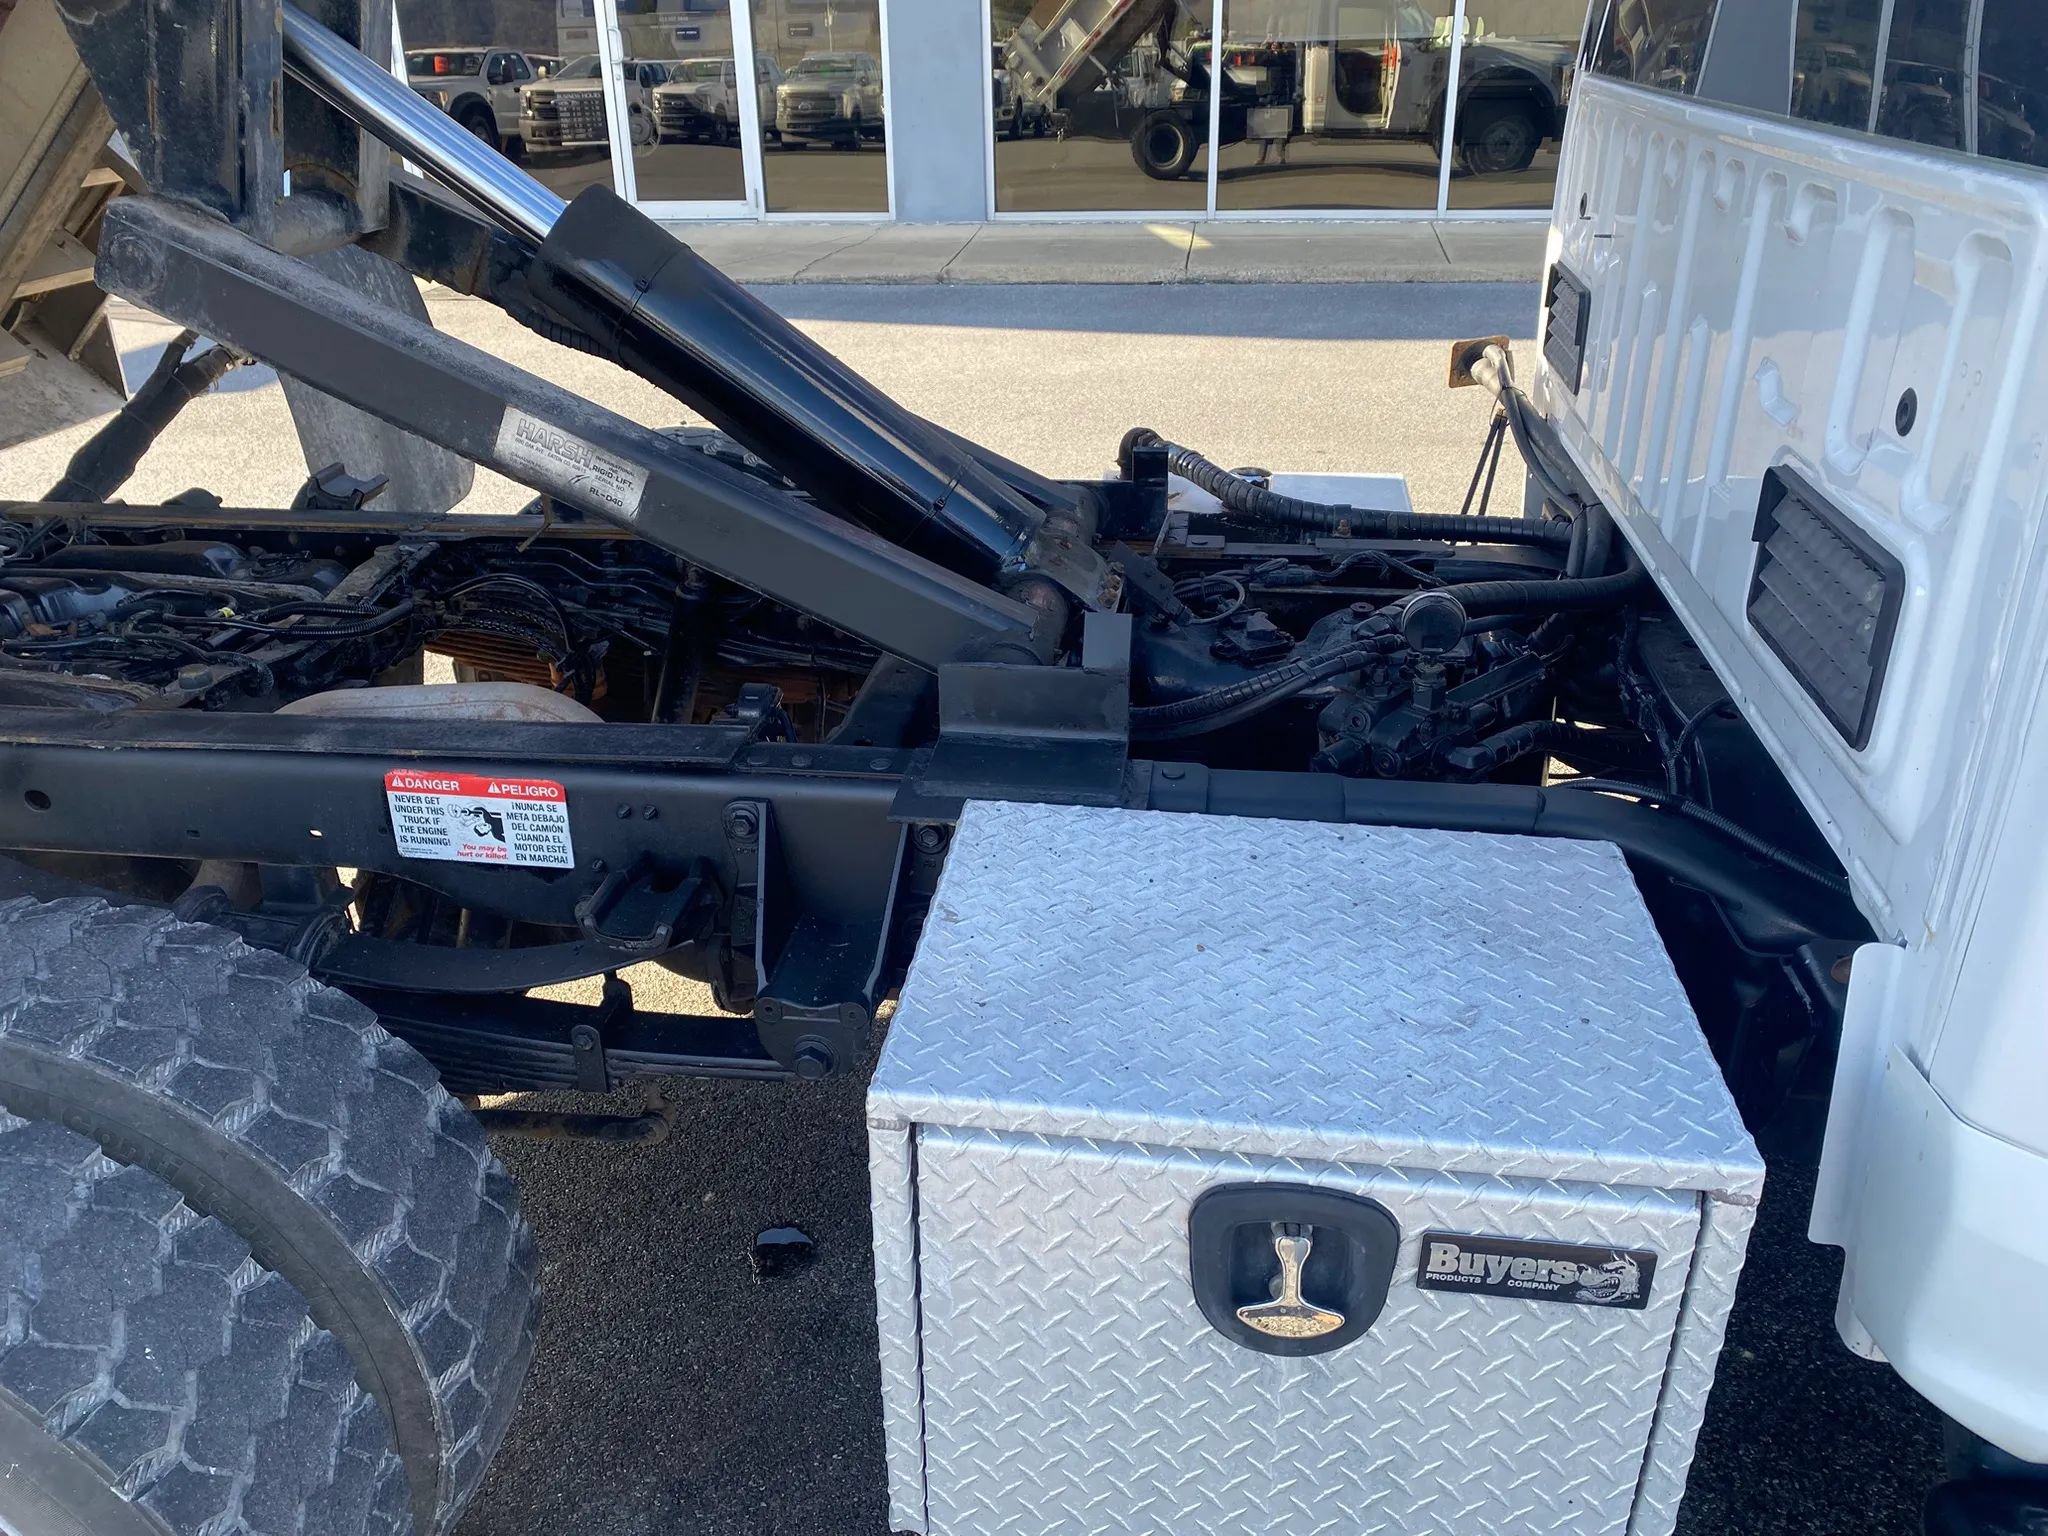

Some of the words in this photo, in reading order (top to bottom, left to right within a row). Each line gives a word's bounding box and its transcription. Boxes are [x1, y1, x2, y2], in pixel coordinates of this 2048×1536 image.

[516, 418, 593, 469] HARSH
[548, 451, 563, 462] EATON
[596, 456, 635, 477] INTERNATIONAL
[595, 474, 614, 487] SERIAL
[405, 778, 459, 791] DANGER
[501, 784, 558, 797] PELIGRO
[394, 795, 422, 804] NEVER
[425, 797, 440, 805] GET
[394, 805, 423, 814] UNDER
[425, 807, 444, 816] THIS
[403, 816, 431, 825] TRUCK
[506, 812, 530, 821] META
[532, 814, 565, 823] DEBAJO
[400, 825, 415, 833] THE
[418, 827, 448, 836] ENGINE
[512, 823, 528, 831] DEL
[530, 824, 563, 833] CAMIÓN
[410, 836, 451, 846] RUNNING!
[514, 843, 544, 852] MOTOR
[547, 844, 567, 854] ESTÉ
[529, 854, 568, 864] MARCHA!
[1427, 1242, 1578, 1285] Buyers
[1425, 1272, 1482, 1284] PRODUCTS
[1507, 1279, 1560, 1291] COMPANY
